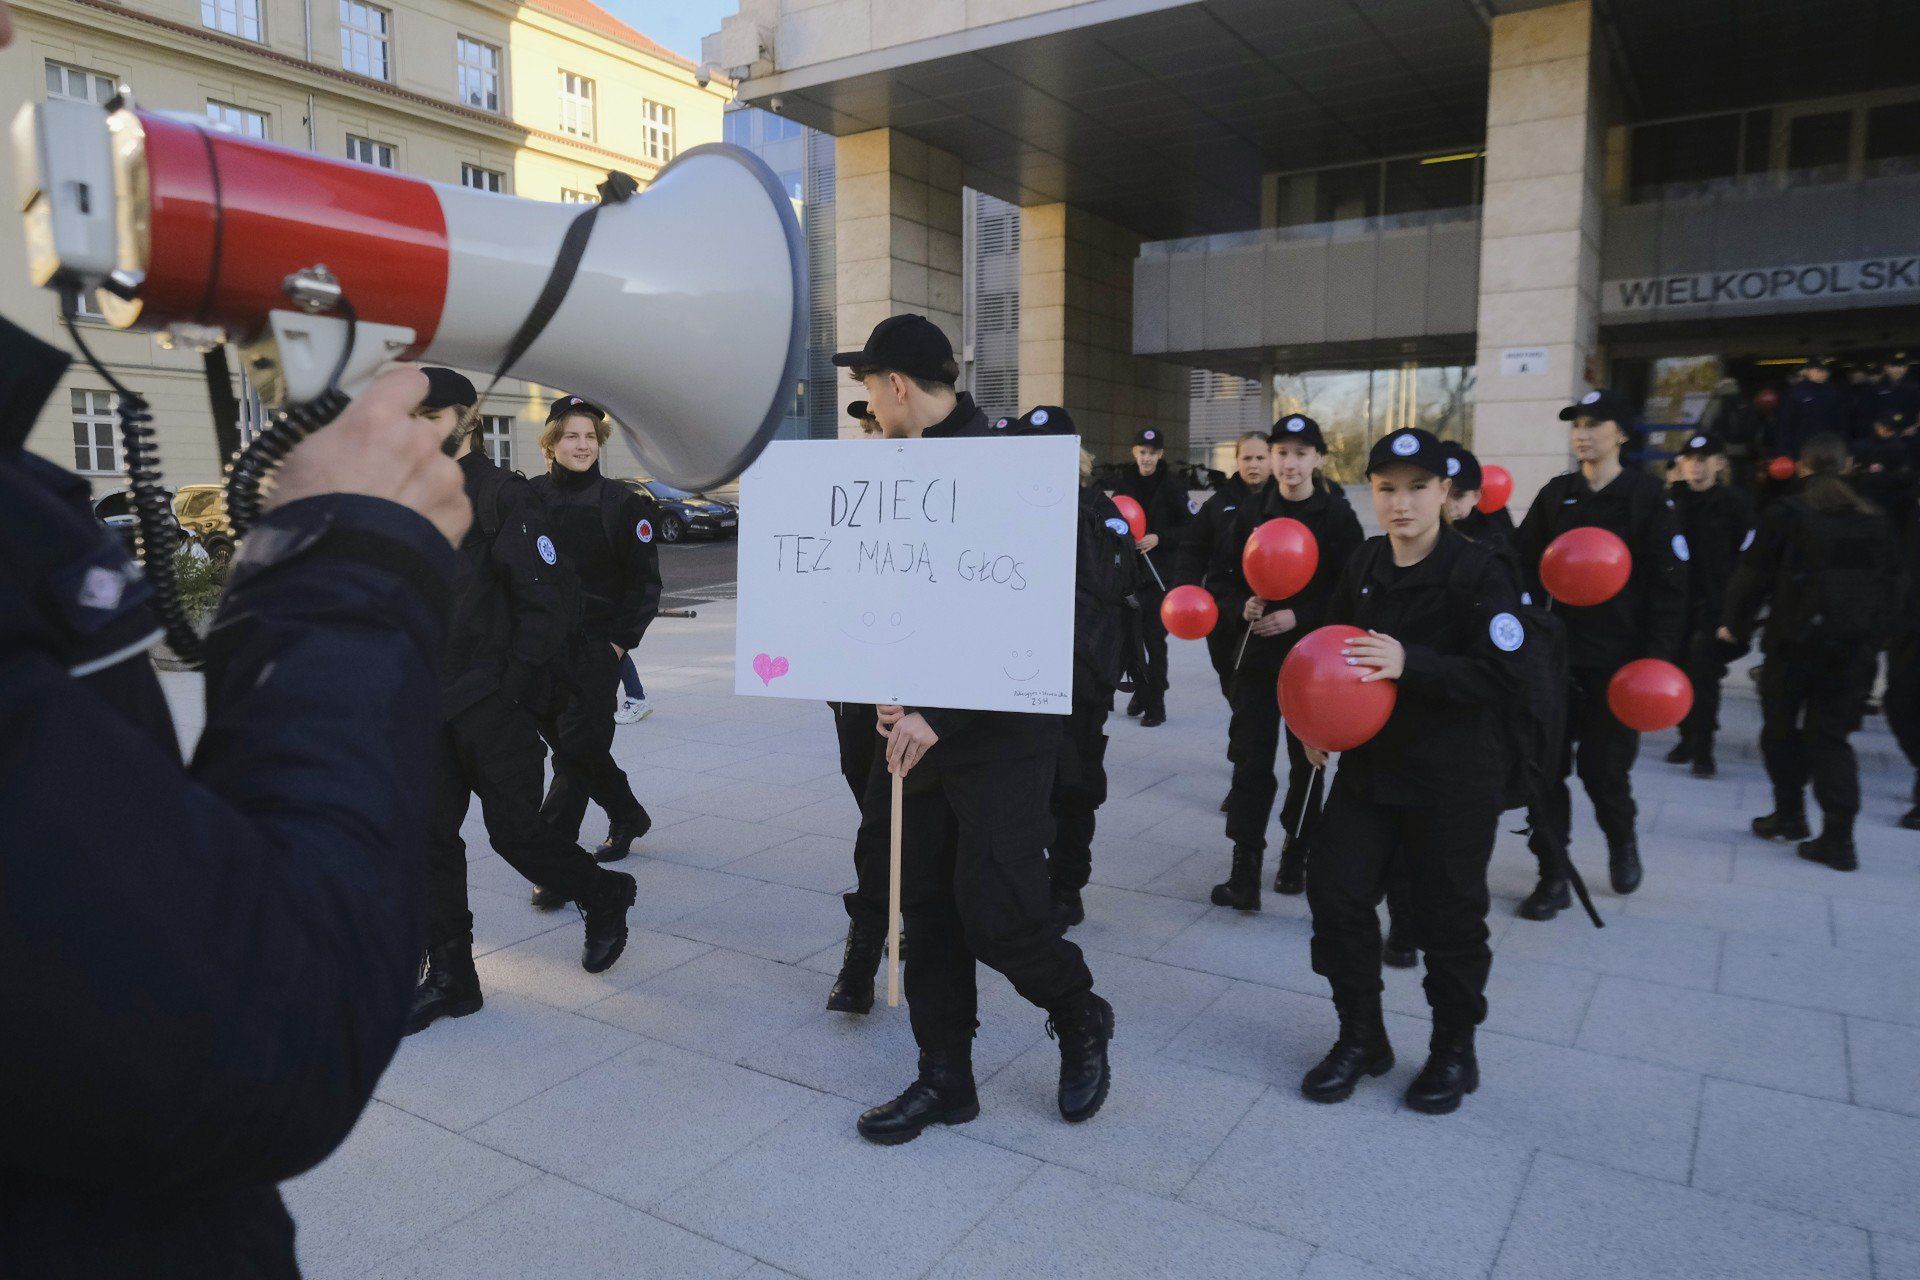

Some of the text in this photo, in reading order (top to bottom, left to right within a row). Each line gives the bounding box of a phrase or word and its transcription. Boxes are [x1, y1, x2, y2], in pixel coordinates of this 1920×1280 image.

[1618, 258, 1920, 308] WIELKOPOLSK
[830, 478, 957, 528] DZIECI
[773, 531, 1028, 591] TEŻ MAJĄ GŁOS
